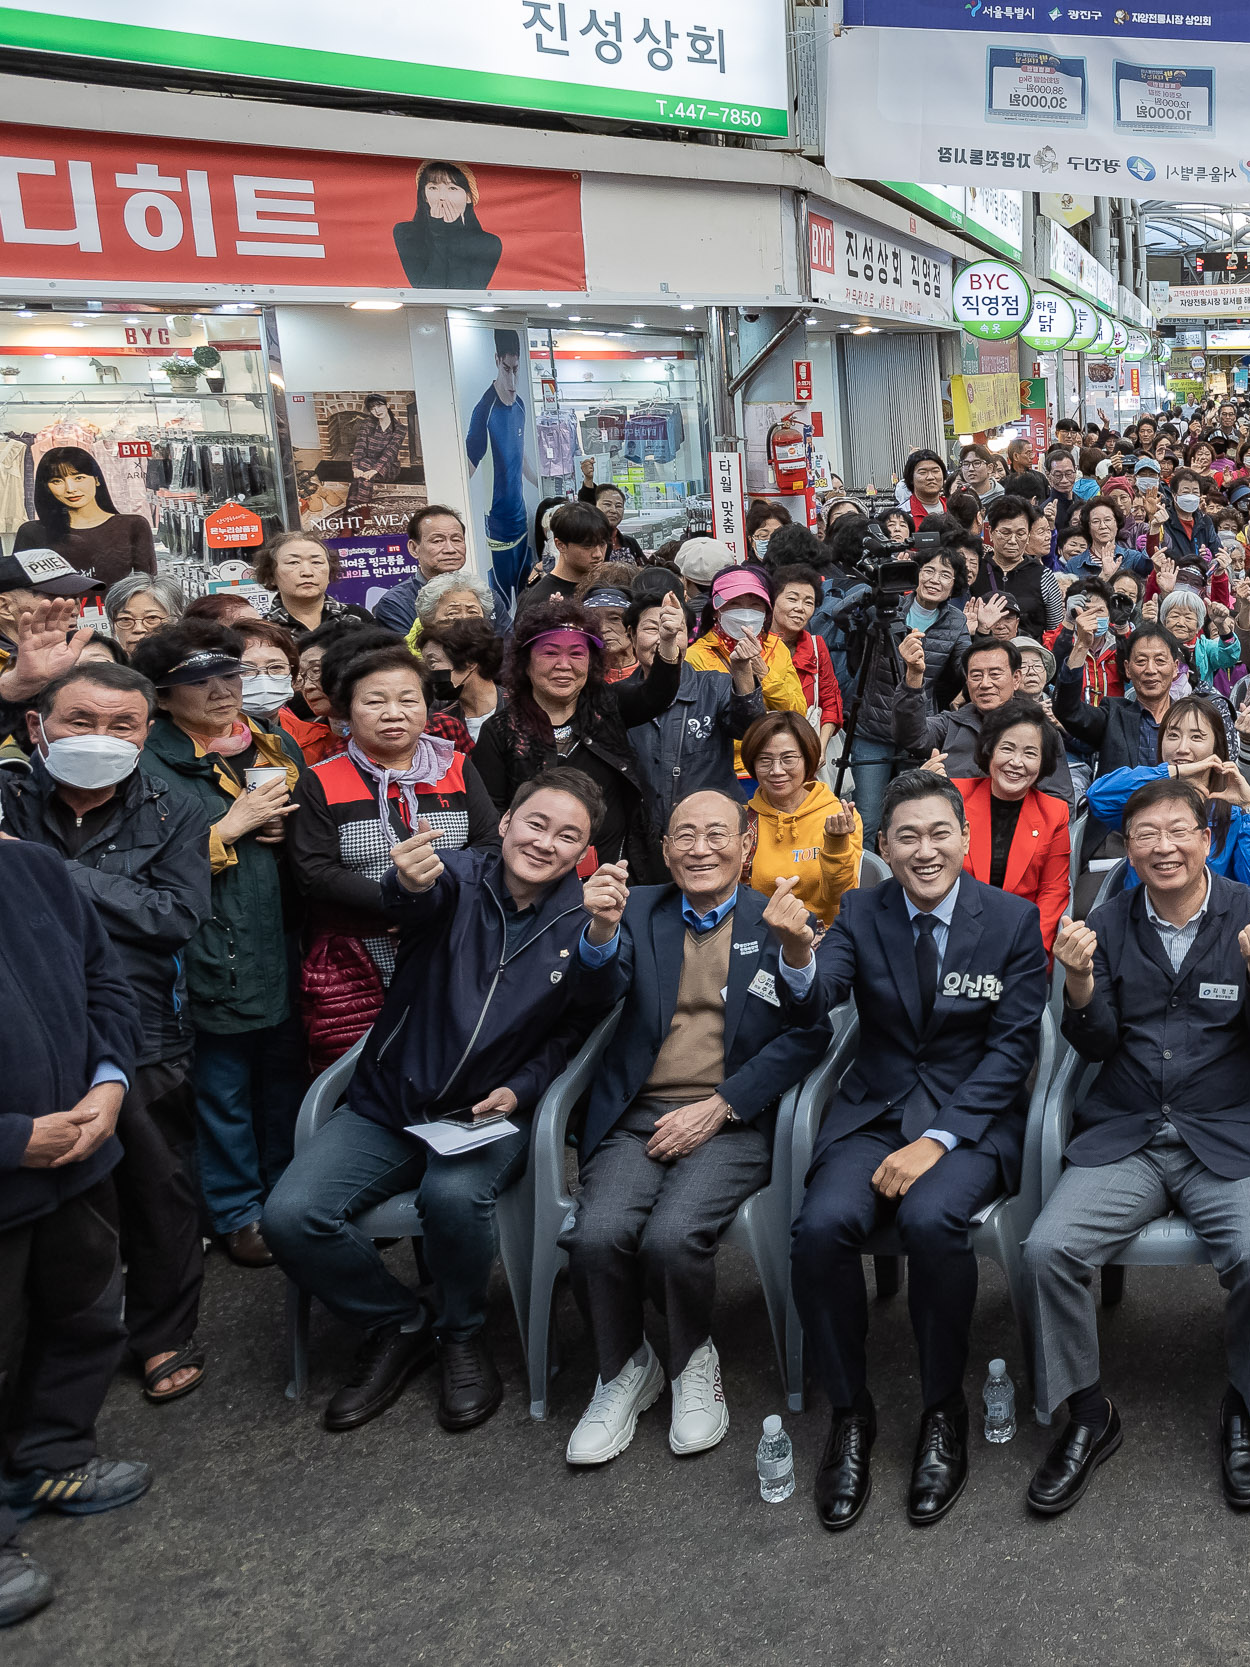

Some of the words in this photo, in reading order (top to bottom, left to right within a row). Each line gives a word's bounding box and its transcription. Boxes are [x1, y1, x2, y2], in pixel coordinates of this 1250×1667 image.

[982, 5, 1035, 20] 서울특별시
[1067, 9, 1103, 21] 광진구
[1131, 12, 1184, 25] 자양전통시장
[1185, 15, 1212, 26] 상인회
[522, 0, 727, 74] 진성상회
[654, 98, 763, 129] T.447-7850
[811, 222, 832, 269] BYC
[845, 230, 903, 289] 진성상회
[911, 254, 941, 299] 직영점
[970, 274, 1009, 290] BYC
[962, 295, 1019, 316] 직영점
[1035, 301, 1057, 314] 하림
[1180, 298, 1221, 307] 자양전통시장
[980, 323, 1001, 335] 속옷
[1038, 315, 1054, 333] 닭
[124, 327, 170, 345] BYC
[121, 443, 149, 456] BYC
[718, 458, 732, 494] 타월
[311, 516, 362, 531] NIGHT
[720, 499, 735, 535] 맞춤
[210, 525, 259, 535] 온누리상품권
[223, 533, 248, 542] 가맹점
[942, 971, 1003, 1001] 오신환
